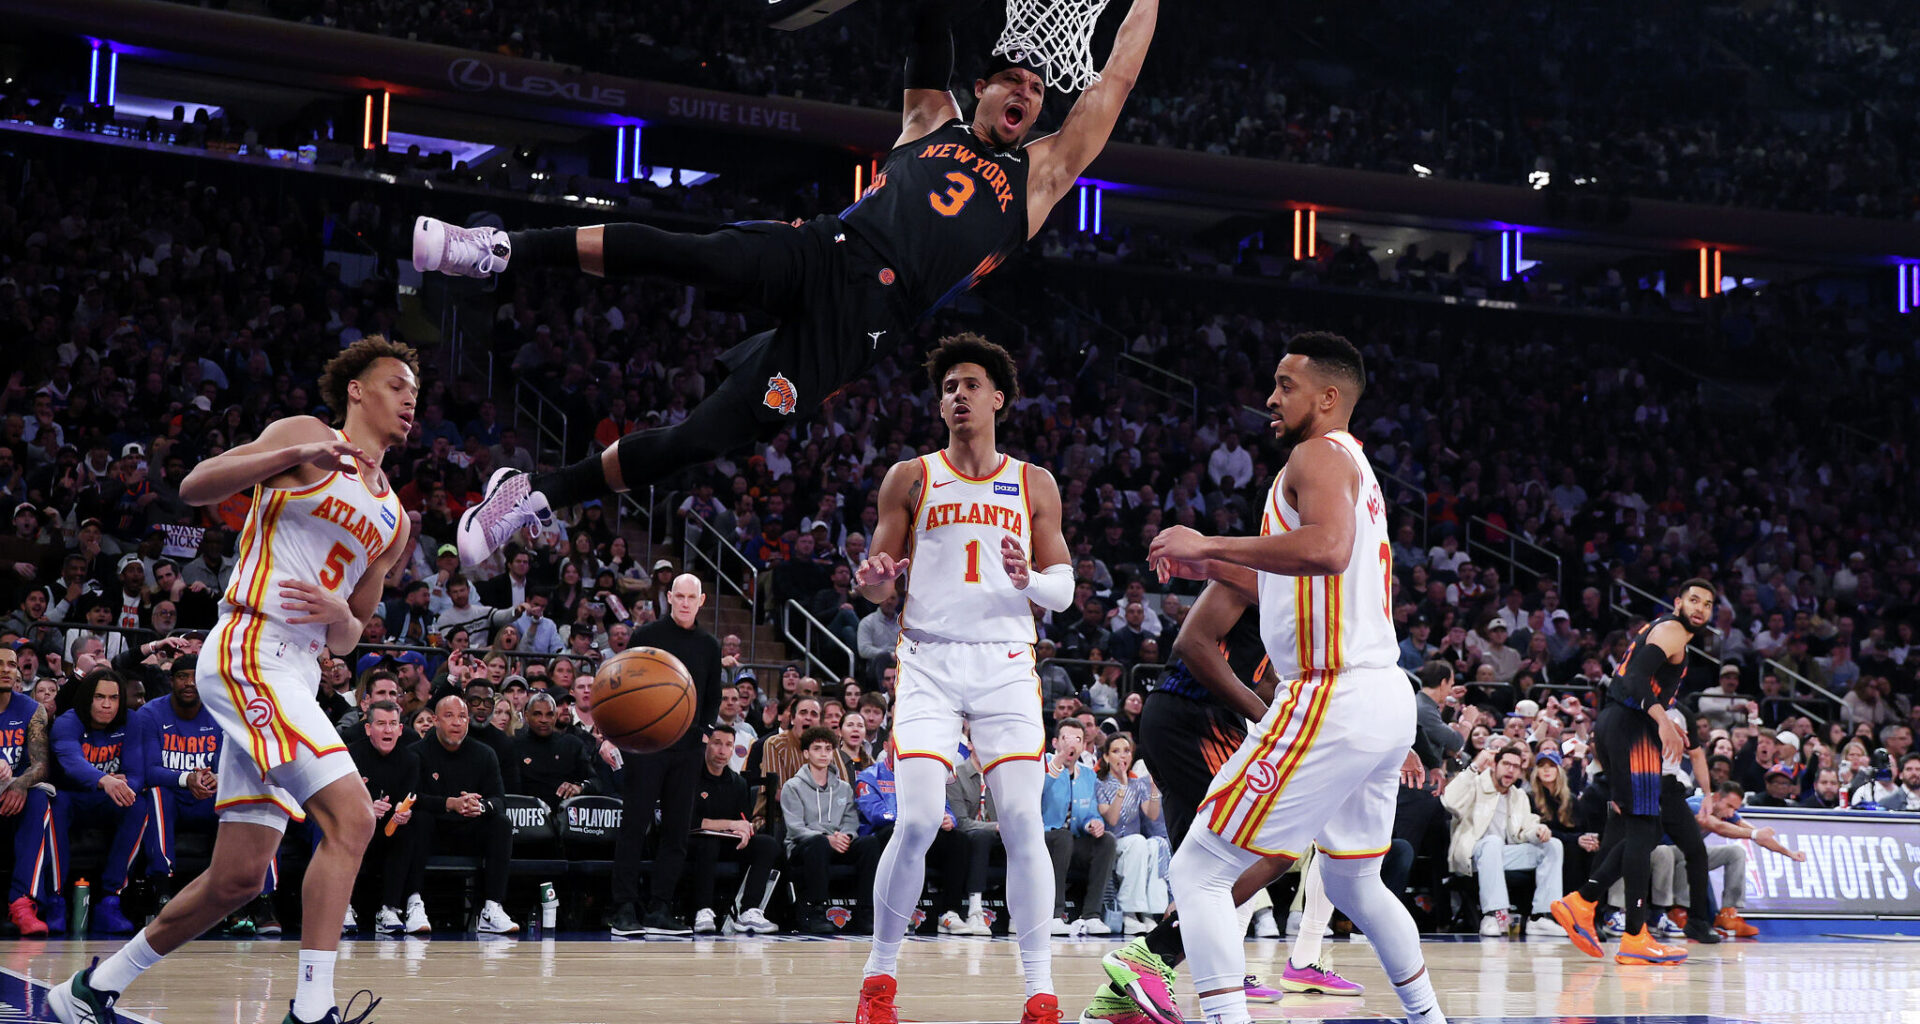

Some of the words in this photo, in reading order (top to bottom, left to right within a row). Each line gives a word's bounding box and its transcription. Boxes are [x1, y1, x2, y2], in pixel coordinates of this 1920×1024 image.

[500, 71, 627, 107] LEXUS
[668, 96, 732, 122] SUITE
[738, 104, 801, 132] LEVEL
[918, 143, 977, 164] NEW
[971, 157, 1014, 214] YORK
[928, 171, 976, 217] 3
[994, 484, 1018, 493] paze
[163, 525, 204, 537] LWAYS
[925, 502, 1023, 538] ATLANTA
[164, 533, 202, 549] NICKS
[319, 541, 357, 592] 5
[964, 539, 981, 583] 1
[506, 808, 545, 827] AYOFFS
[579, 807, 623, 828] PLAYOFF
[1761, 834, 1908, 900] PLAYOFFS
